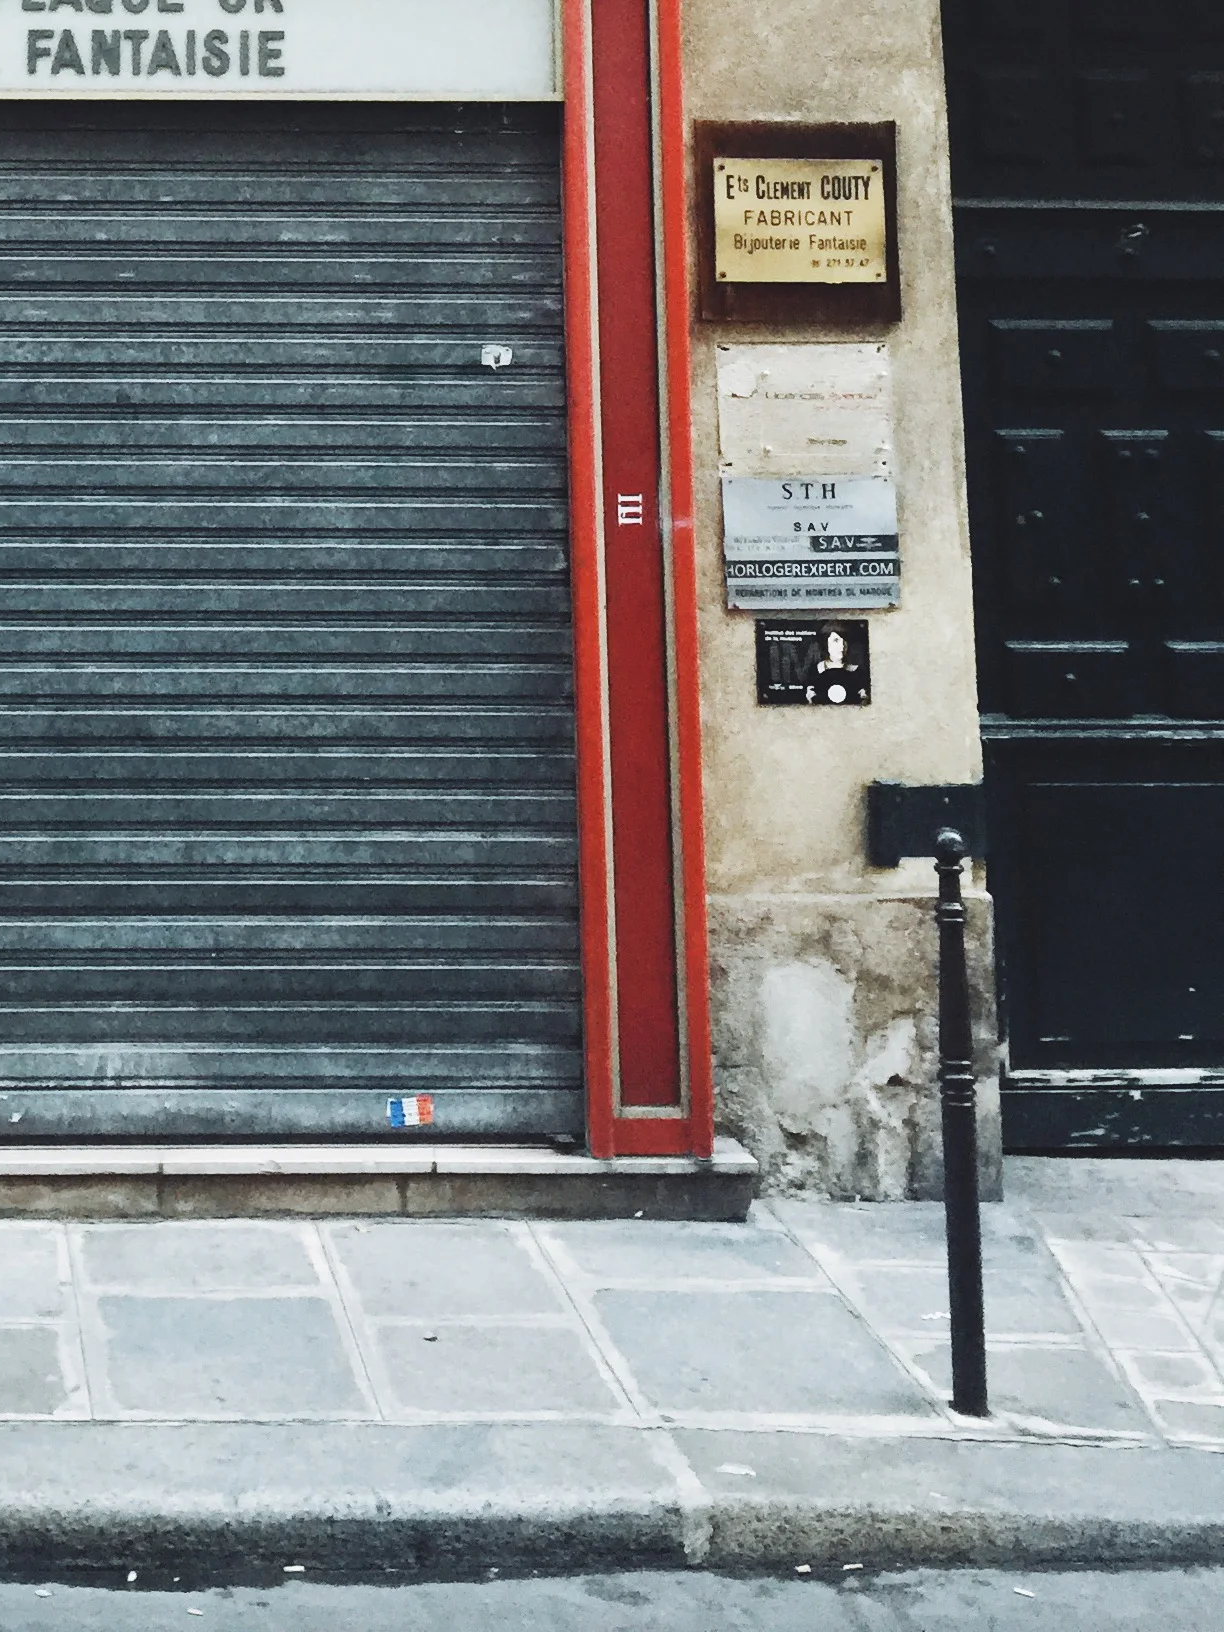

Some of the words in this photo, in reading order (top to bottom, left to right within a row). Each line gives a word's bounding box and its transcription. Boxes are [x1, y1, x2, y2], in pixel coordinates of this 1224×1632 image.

[26, 28, 286, 78] FANTAISIE
[726, 174, 749, 200] Ets
[820, 175, 871, 200] COUTY
[743, 210, 854, 226] FABRICANT
[733, 233, 800, 254] Bijouterie
[809, 233, 868, 251] Fantaisie
